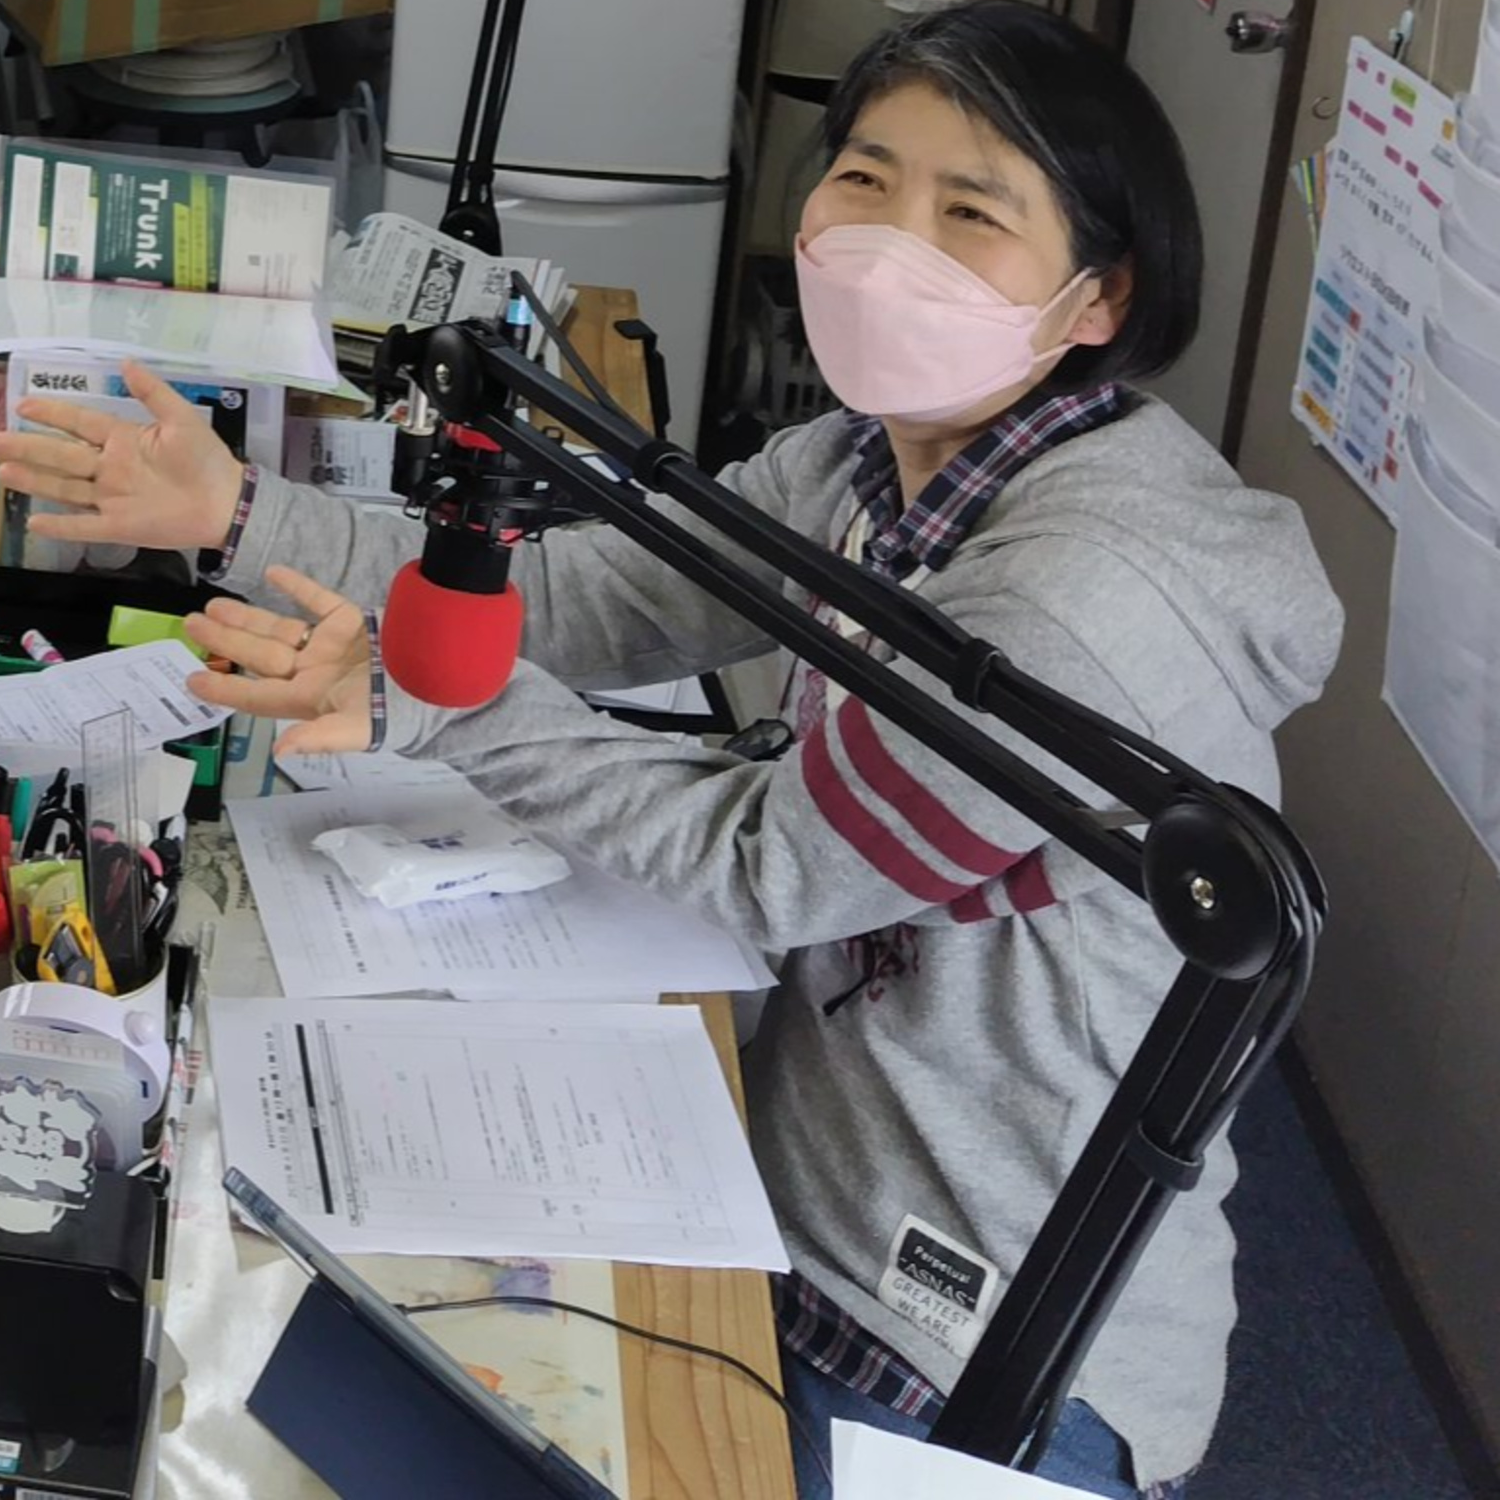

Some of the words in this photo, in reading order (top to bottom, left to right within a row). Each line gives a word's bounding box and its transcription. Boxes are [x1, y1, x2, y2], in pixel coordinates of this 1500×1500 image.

[134, 178, 169, 270] Trunk
[913, 1245, 971, 1284] Perpetual
[893, 1276, 973, 1327] GREATEST
[898, 1298, 920, 1319] WE
[922, 1314, 952, 1339] ARE
